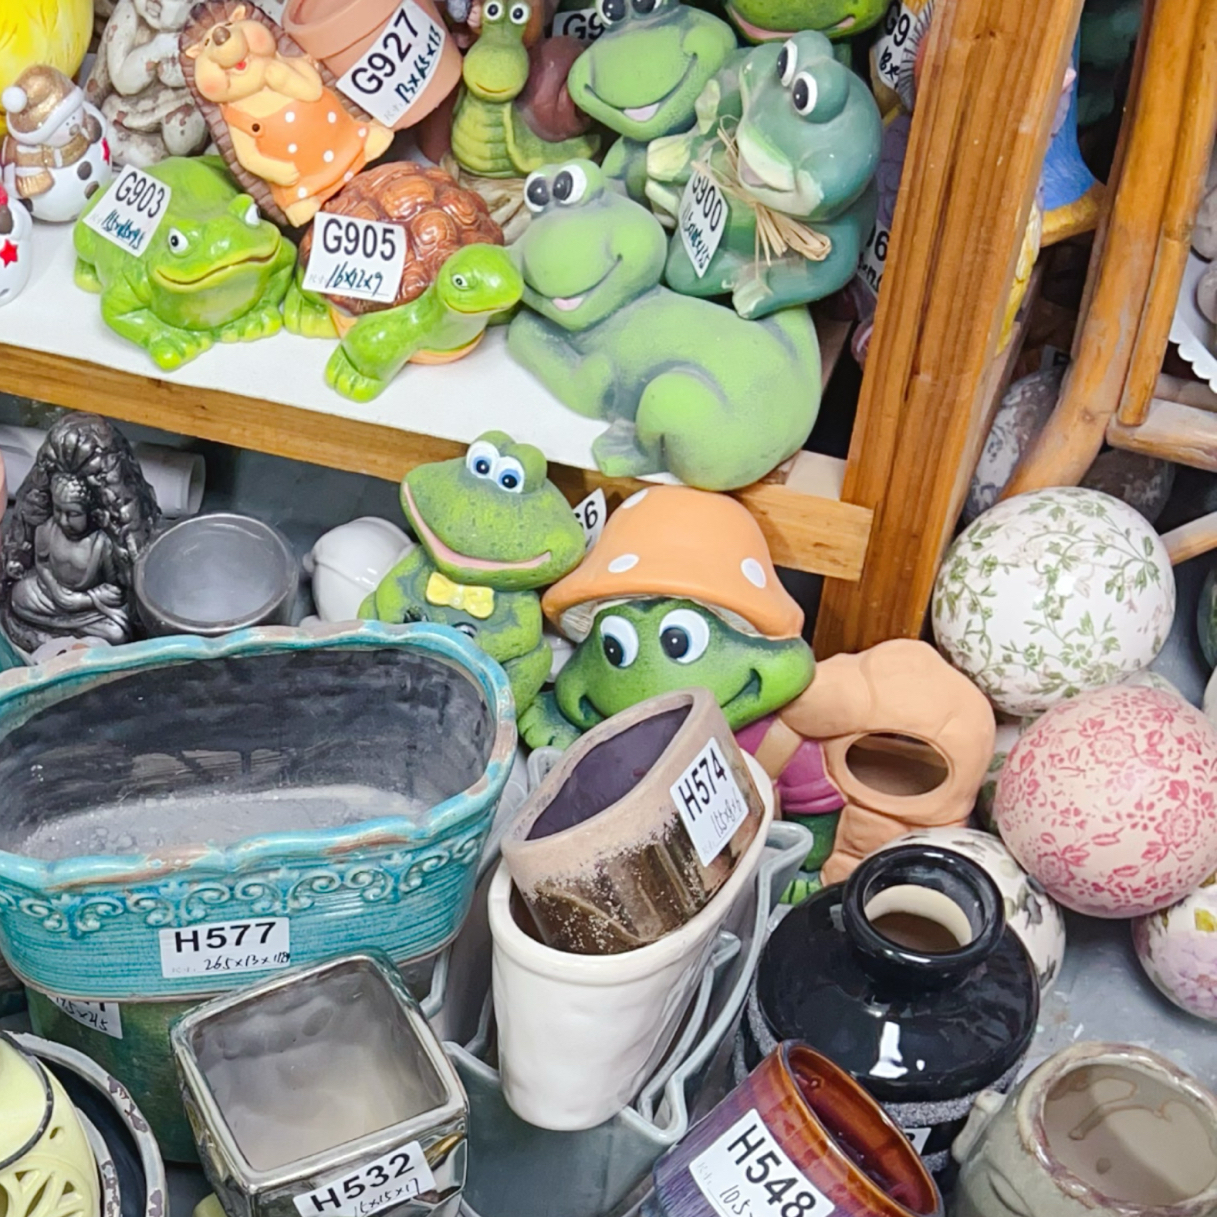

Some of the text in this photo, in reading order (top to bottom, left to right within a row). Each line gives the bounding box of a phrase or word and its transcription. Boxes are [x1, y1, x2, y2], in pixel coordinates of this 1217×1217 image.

[352, 11, 419, 95] G927
[116, 173, 164, 217] G903
[323, 219, 396, 260] G905
[678, 750, 726, 820] H574
[174, 922, 277, 953] H577
[311, 1153, 415, 1212] H532
